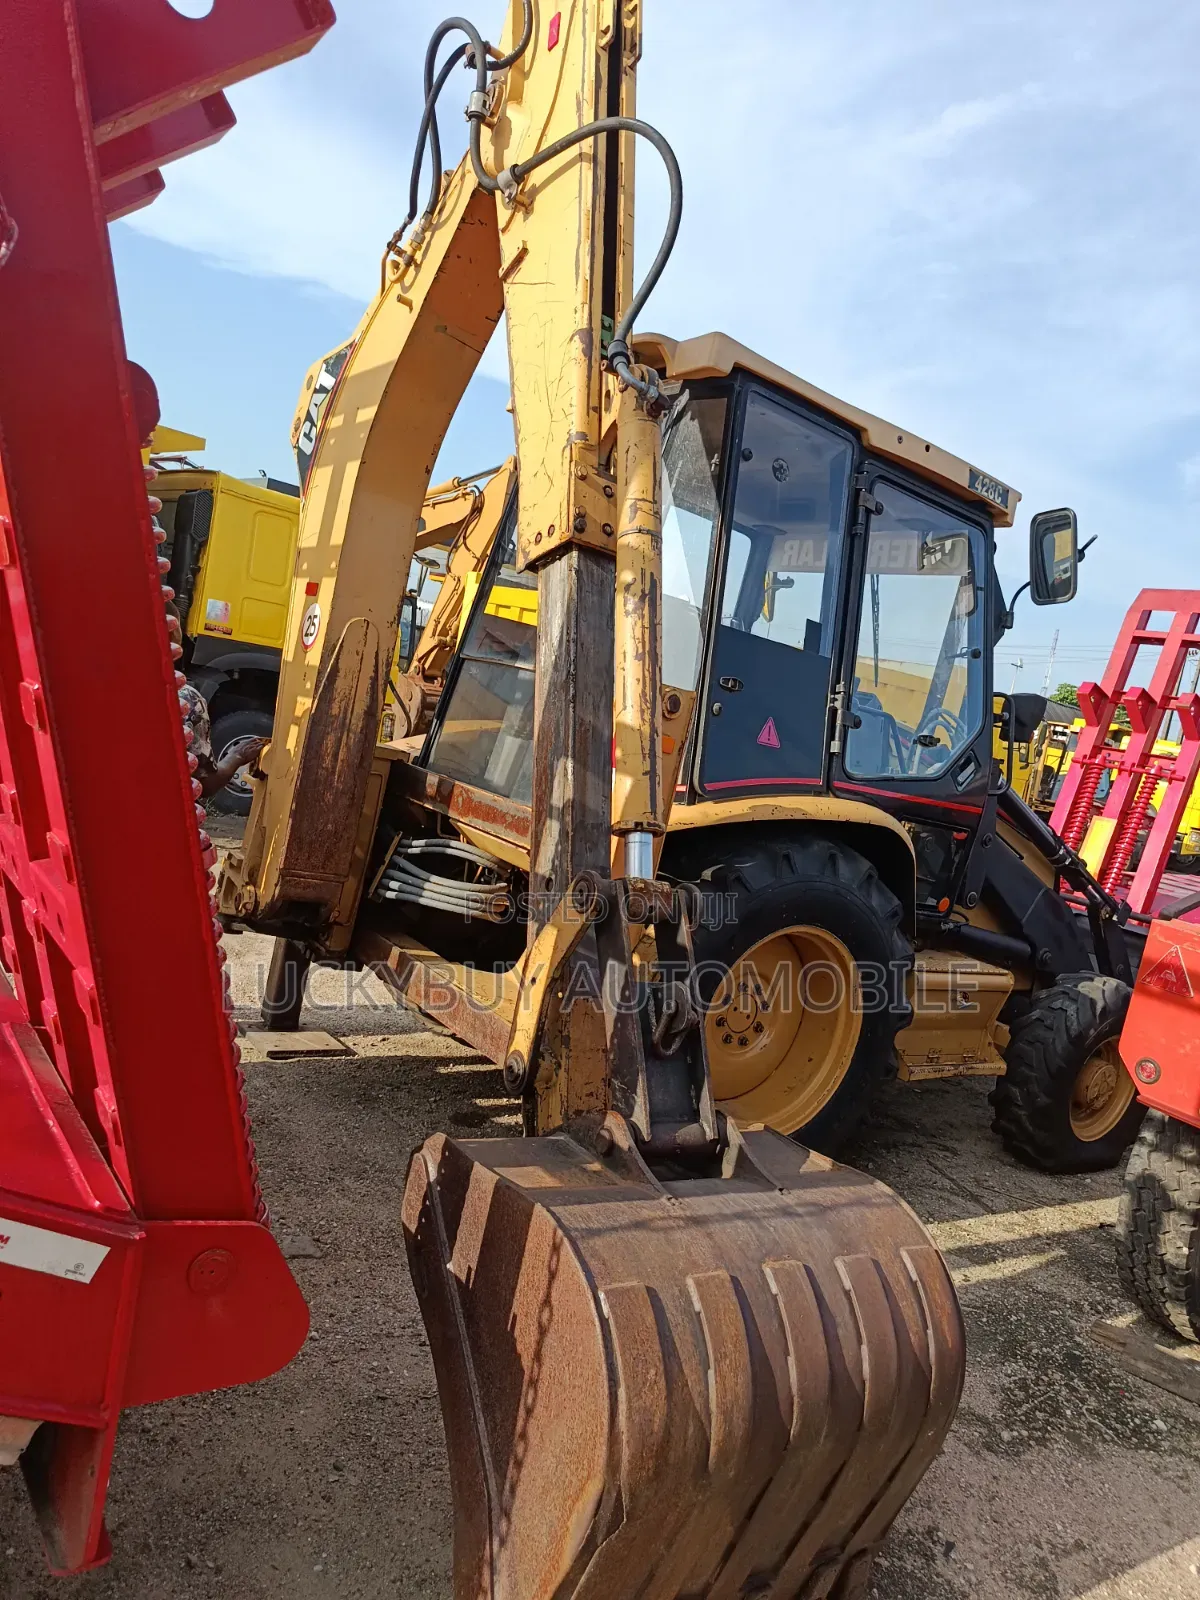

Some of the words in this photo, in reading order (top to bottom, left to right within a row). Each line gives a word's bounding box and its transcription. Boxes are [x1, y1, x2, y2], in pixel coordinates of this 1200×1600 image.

[298, 363, 336, 456] CAT
[975, 475, 1002, 504] 428C
[304, 615, 318, 637] 25
